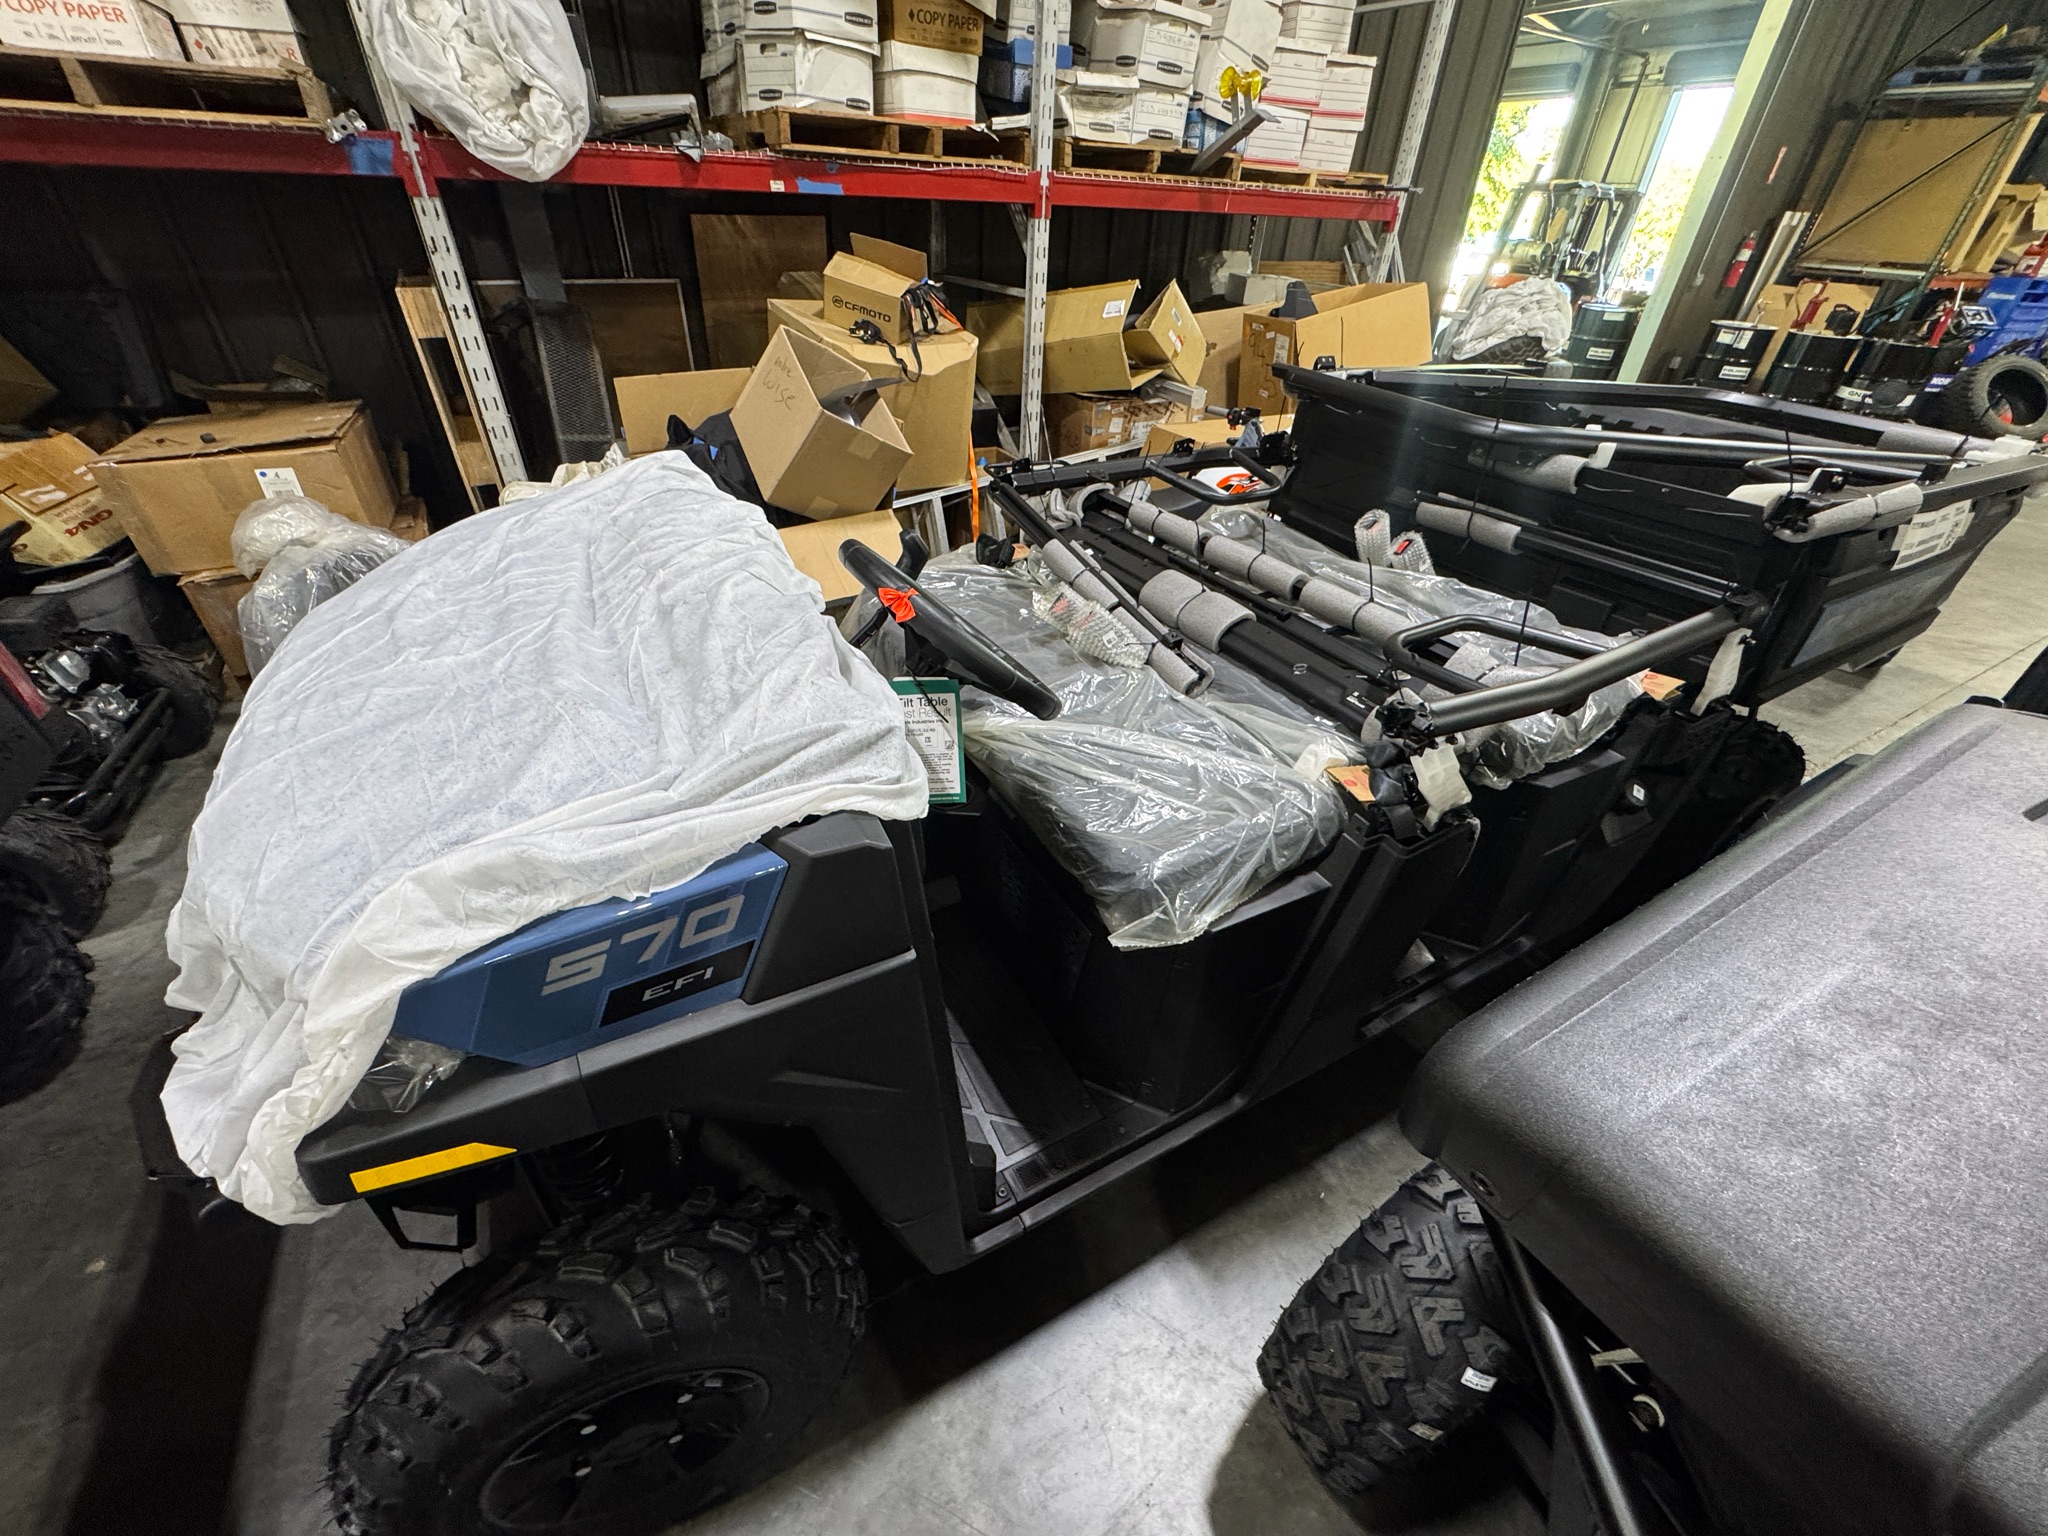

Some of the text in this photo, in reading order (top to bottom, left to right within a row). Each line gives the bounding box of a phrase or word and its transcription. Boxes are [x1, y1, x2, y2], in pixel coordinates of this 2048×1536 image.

[62, 1, 128, 23] PAPER
[916, 8, 979, 32] COPY PAPER
[844, 299, 891, 323] CFMOTO
[917, 696, 948, 708] Table
[540, 894, 745, 997] 570
[641, 966, 714, 1002] EFI
